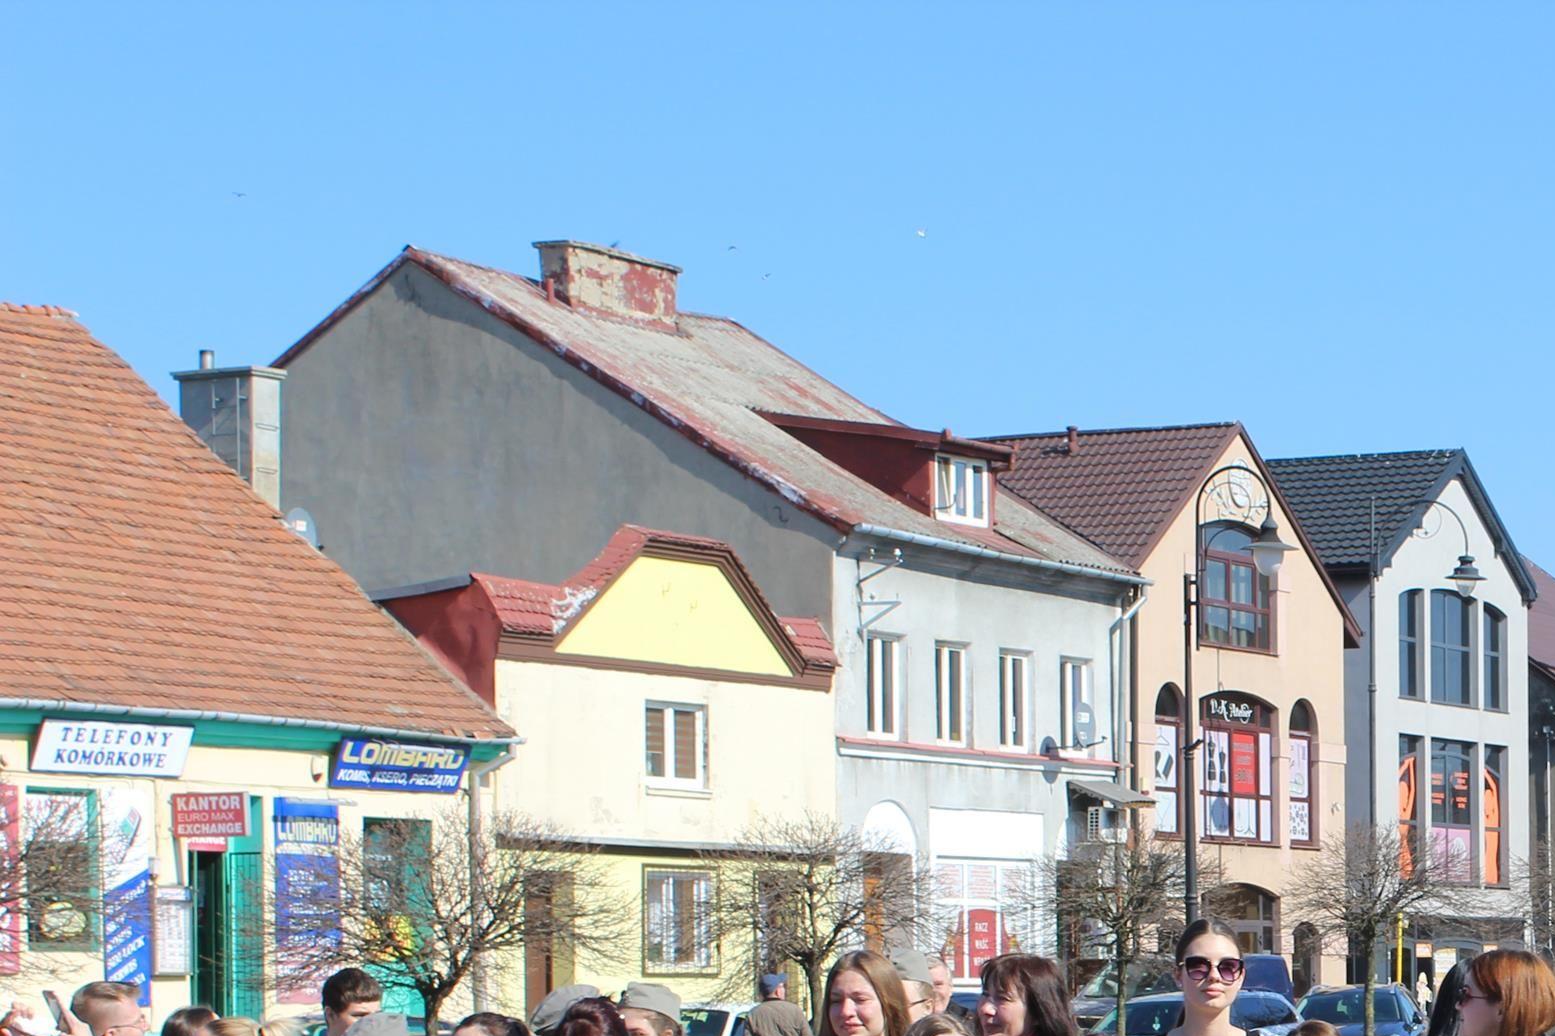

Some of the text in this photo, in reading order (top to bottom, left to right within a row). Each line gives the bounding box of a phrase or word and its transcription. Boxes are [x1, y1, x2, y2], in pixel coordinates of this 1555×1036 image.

[60, 726, 174, 747] TELEFONY
[53, 748, 168, 769] KOMÓRKOWE
[342, 741, 465, 770] LOMBARD
[337, 768, 459, 789] KOMIS, KSERO, PIECZĄTKI
[176, 797, 241, 812] KANTOR
[177, 812, 235, 821] EURO MAX
[177, 822, 243, 835] EXCHANGE
